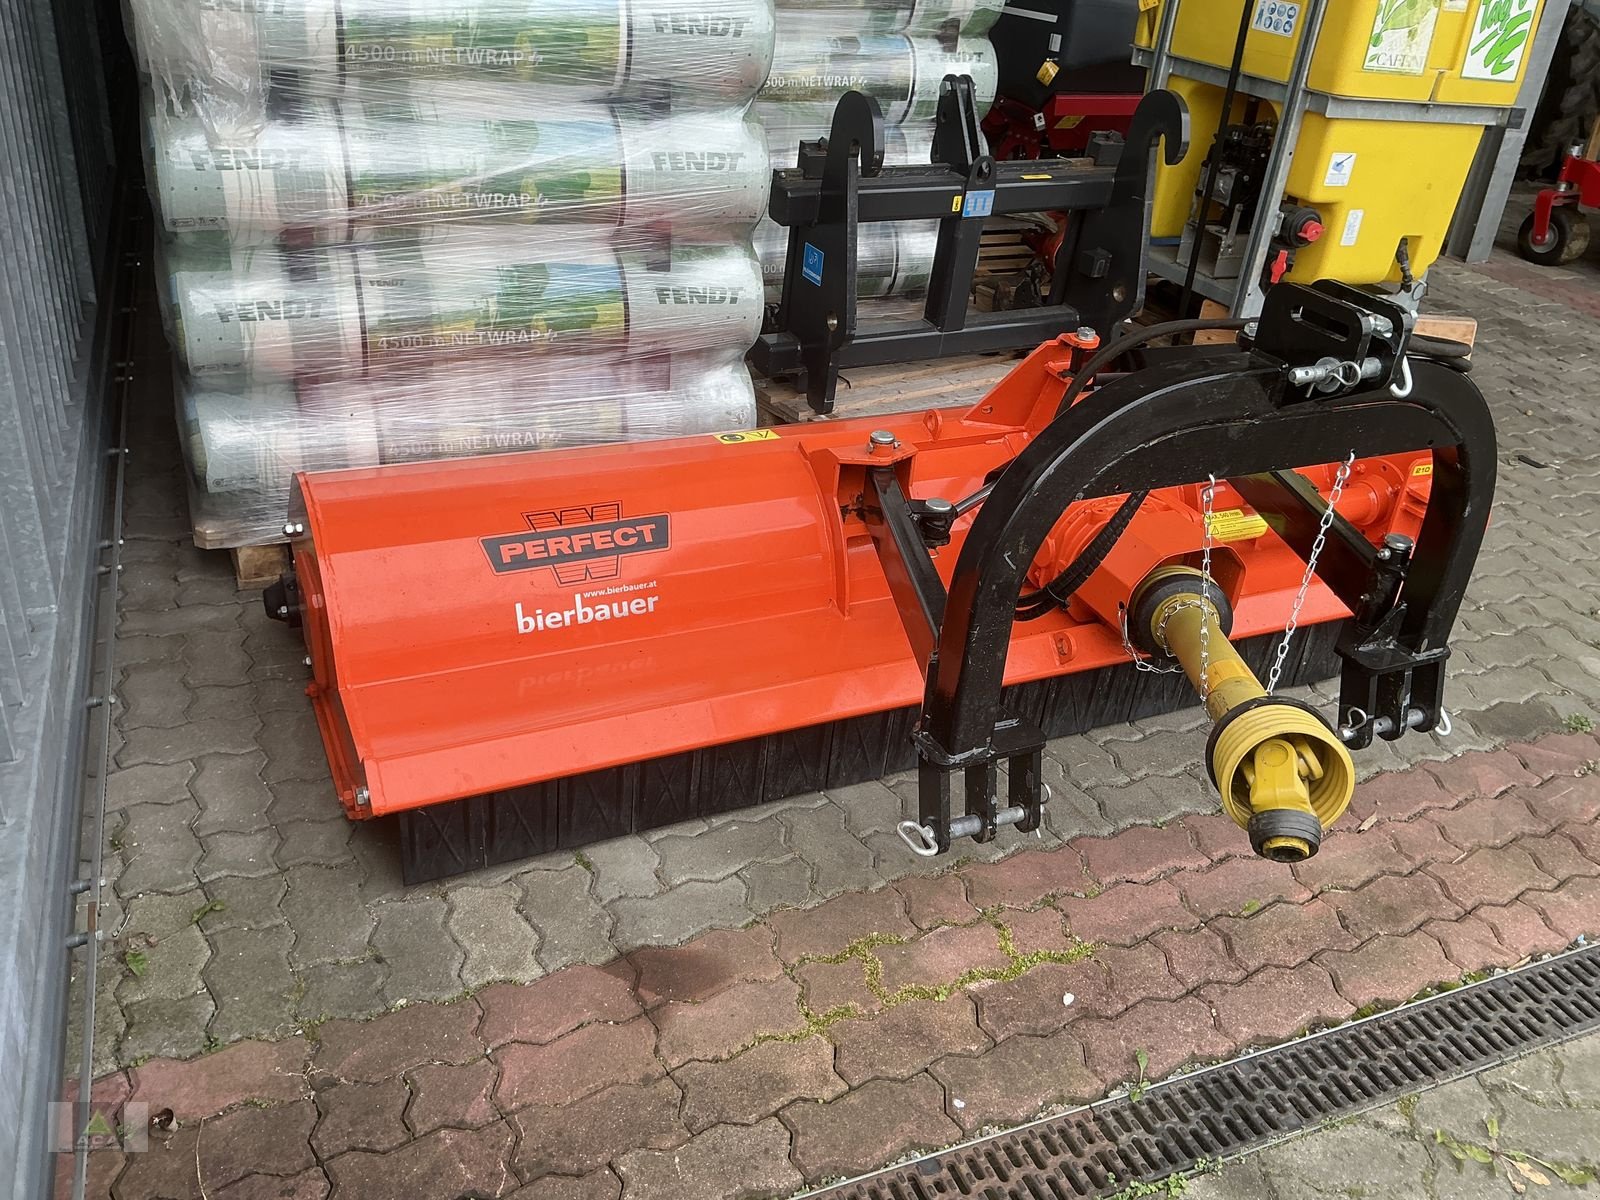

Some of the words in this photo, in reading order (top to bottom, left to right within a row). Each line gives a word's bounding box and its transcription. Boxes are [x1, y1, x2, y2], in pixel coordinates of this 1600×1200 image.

[344, 44, 395, 61] 4500
[426, 47, 523, 65] NETWRAP
[763, 76, 785, 88] 500
[801, 75, 857, 88] NETWRAP
[651, 152, 746, 171] FENDT
[435, 192, 531, 208] NETWRAP
[655, 287, 745, 305] FENDT
[214, 298, 326, 323] FENDT
[378, 335, 423, 350] 4500
[451, 329, 541, 347] NETWRAP
[460, 431, 545, 451] NETWRAP
[499, 524, 656, 563] PERFECT
[583, 580, 657, 598] www.bierbauer.at
[515, 594, 659, 634] bierbauer
